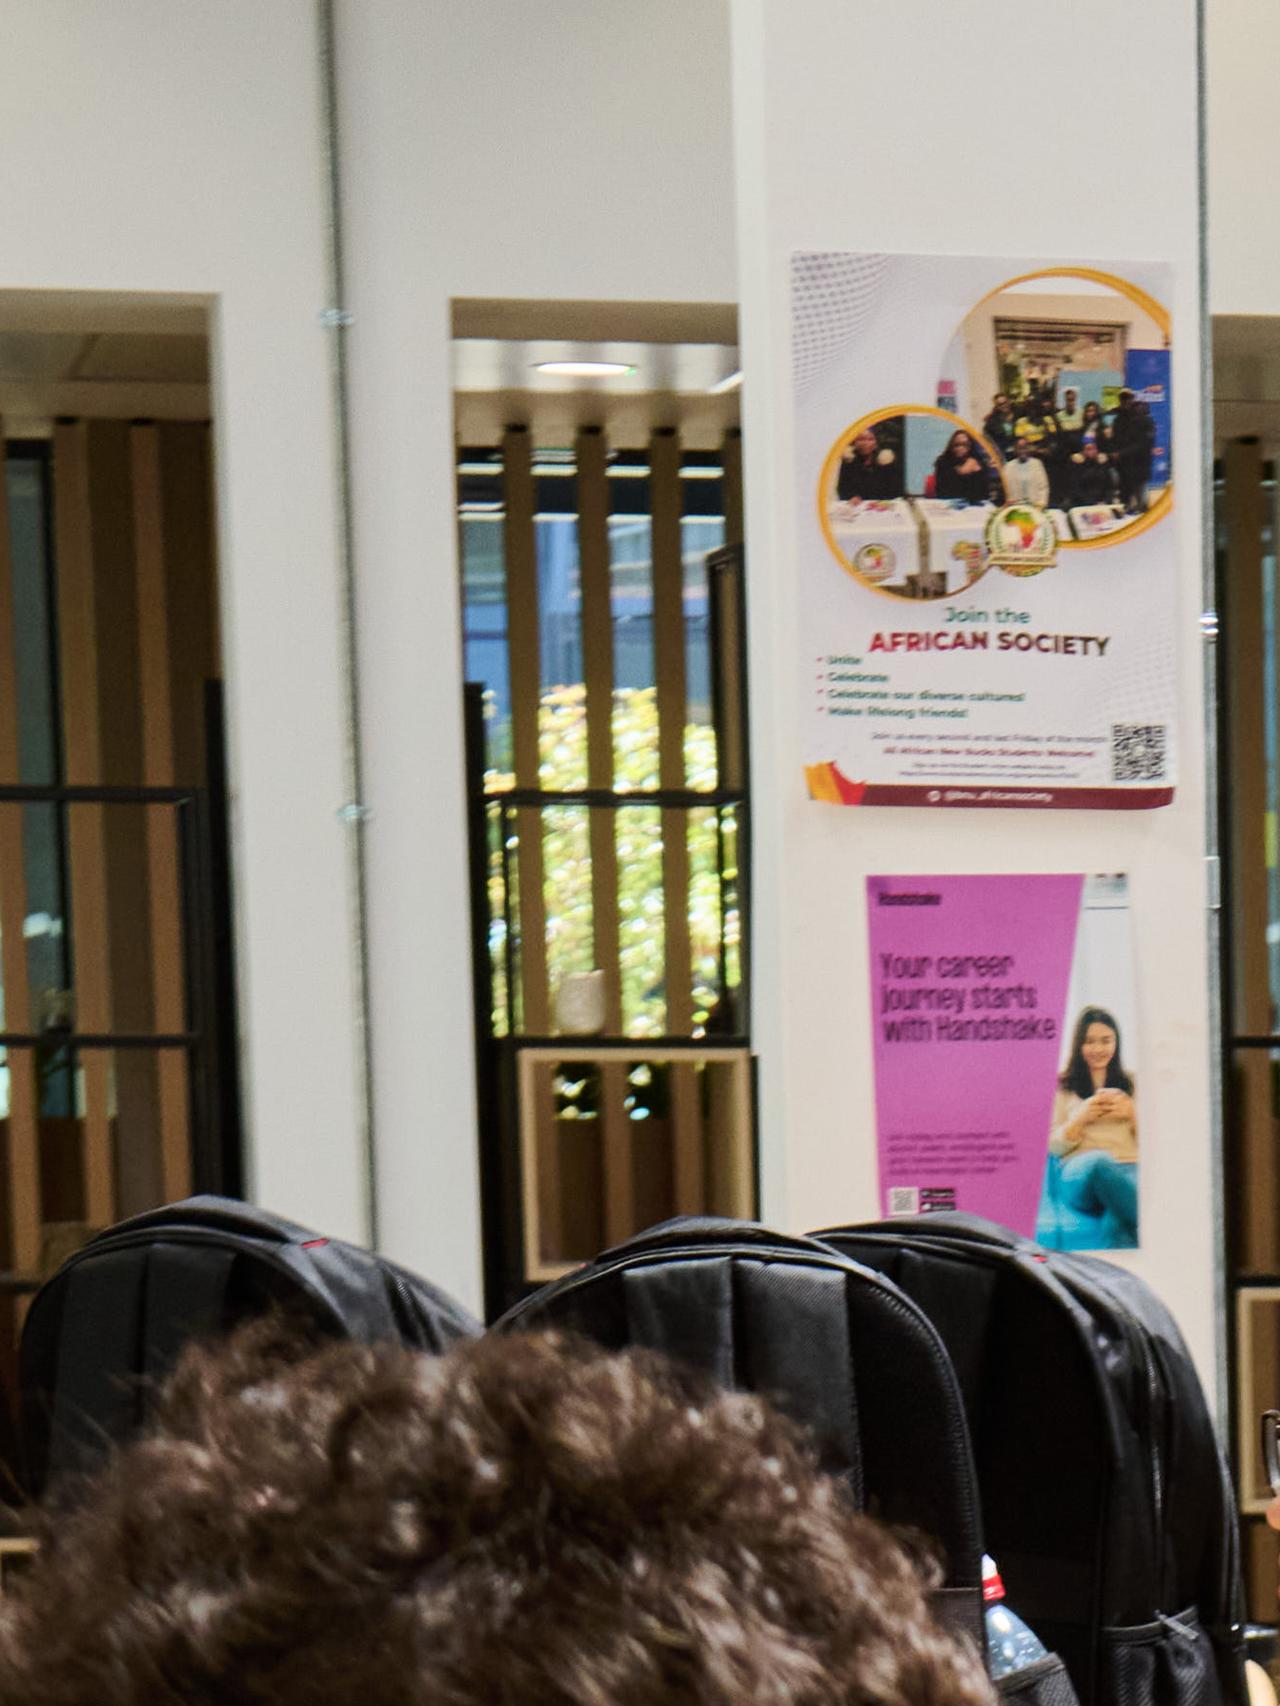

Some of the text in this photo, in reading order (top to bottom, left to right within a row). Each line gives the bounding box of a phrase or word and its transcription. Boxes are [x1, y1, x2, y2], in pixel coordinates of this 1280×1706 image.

[945, 607, 1031, 624] Join the
[868, 631, 1110, 656] AFRICAN SOCIETY
[828, 672, 889, 683] Celebrate
[828, 689, 889, 700] Celebrate
[880, 953, 1014, 979] Your career
[881, 982, 1039, 1014] journey starts
[883, 1014, 1056, 1043] with Handshake
